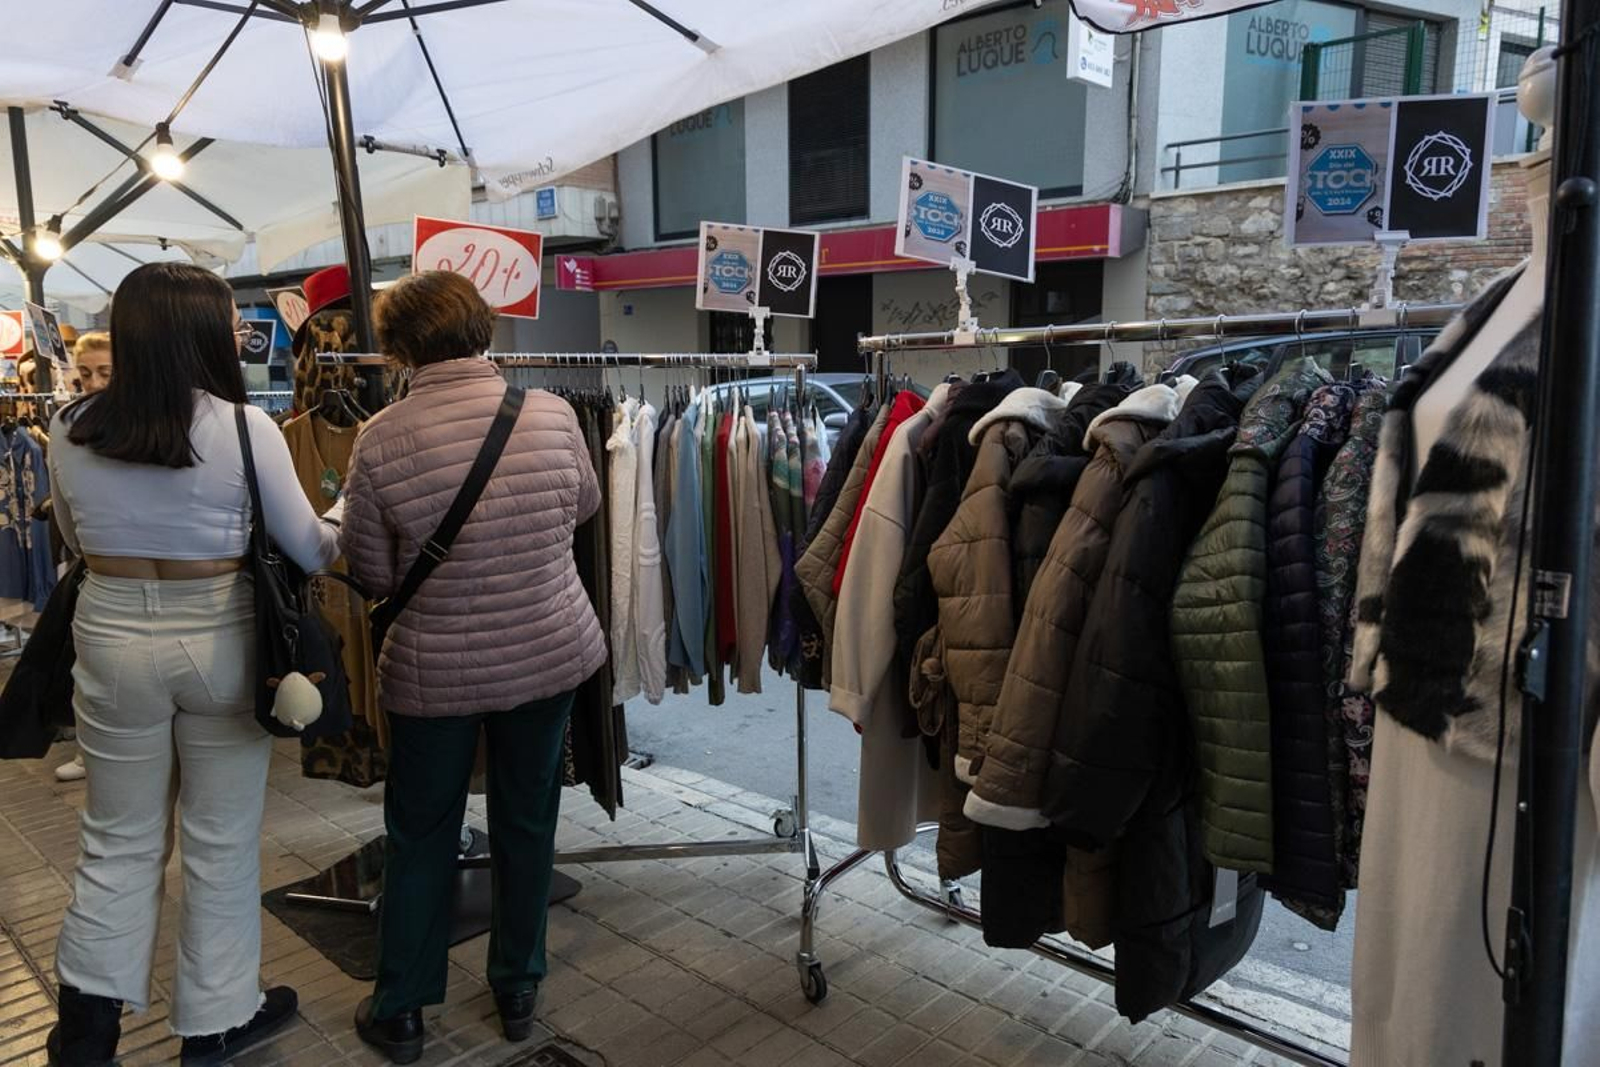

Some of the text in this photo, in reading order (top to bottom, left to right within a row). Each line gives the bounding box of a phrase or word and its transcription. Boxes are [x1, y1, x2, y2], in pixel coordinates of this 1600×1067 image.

[958, 24, 1026, 53] ALBERTO
[1247, 16, 1309, 40] ALBERTO
[956, 42, 1026, 77] LUQUE
[1328, 148, 1357, 160] XXIX
